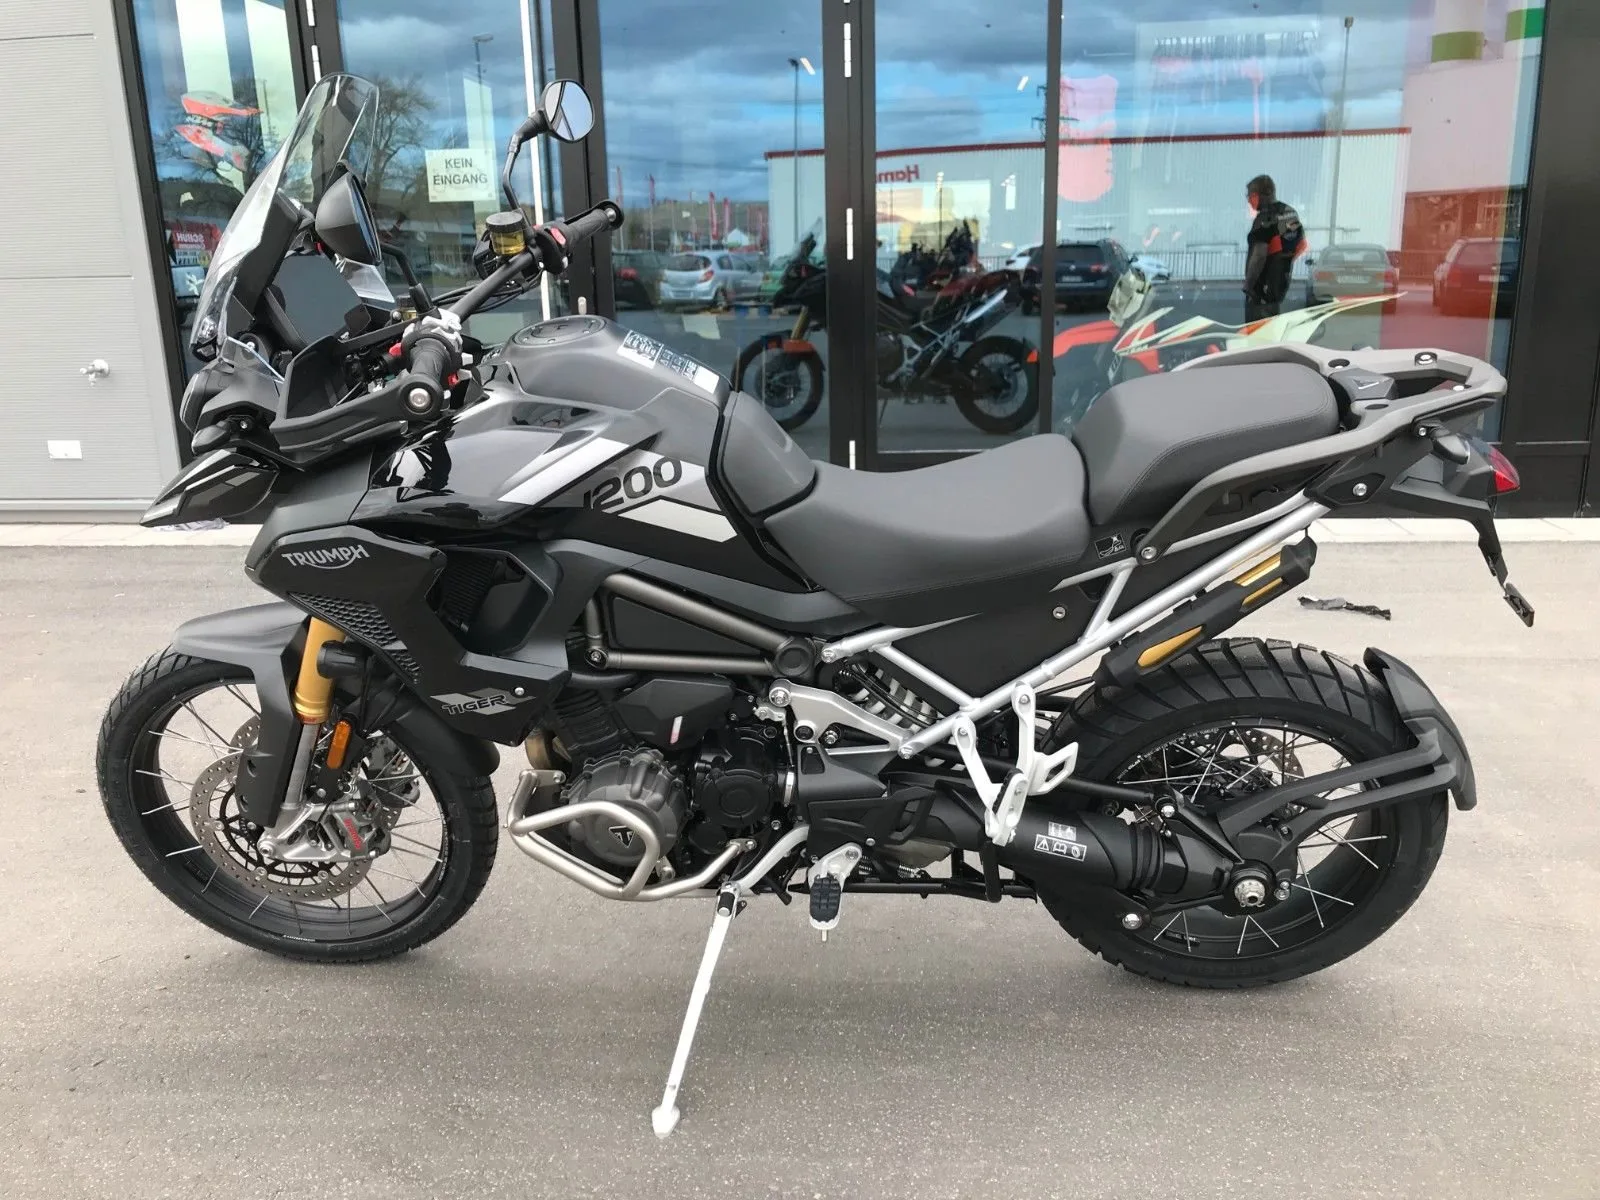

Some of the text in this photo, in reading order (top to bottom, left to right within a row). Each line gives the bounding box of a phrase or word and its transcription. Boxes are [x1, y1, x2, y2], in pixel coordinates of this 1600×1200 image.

[445, 157, 473, 169] KEIN
[433, 173, 488, 185] EINGANG
[583, 456, 683, 514] 1200
[281, 544, 370, 569] TRIUMPH
[441, 694, 507, 715] TIGER
